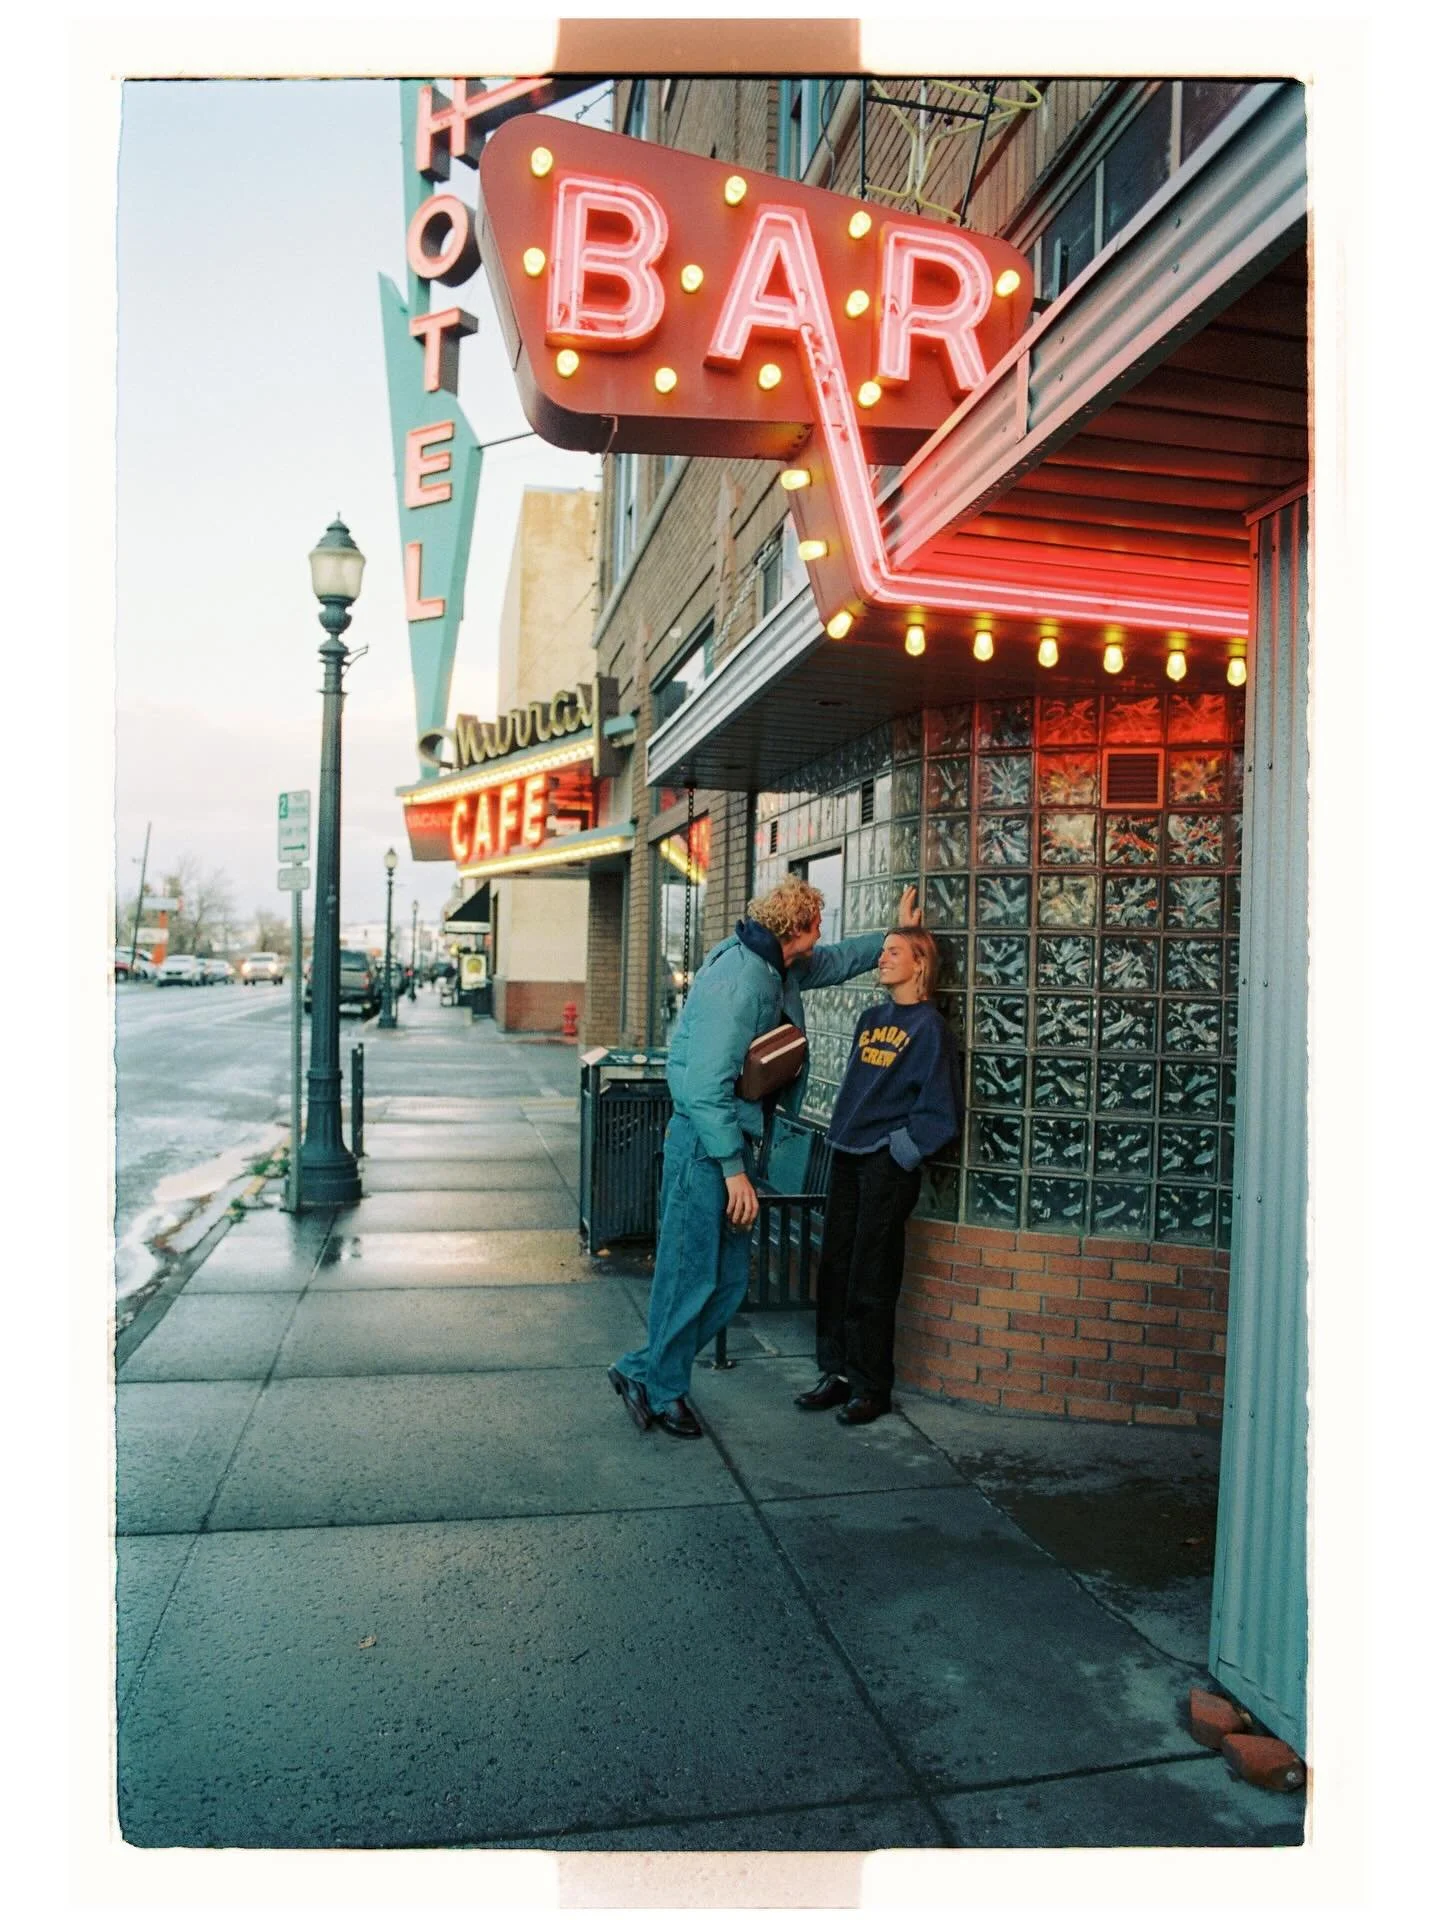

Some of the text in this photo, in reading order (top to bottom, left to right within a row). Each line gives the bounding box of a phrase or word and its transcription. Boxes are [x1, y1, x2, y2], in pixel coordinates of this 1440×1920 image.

[404, 79, 466, 622] HOTEL
[546, 173, 992, 391] BAR
[451, 772, 547, 865] CAFE
[861, 1047, 898, 1067] CREW
